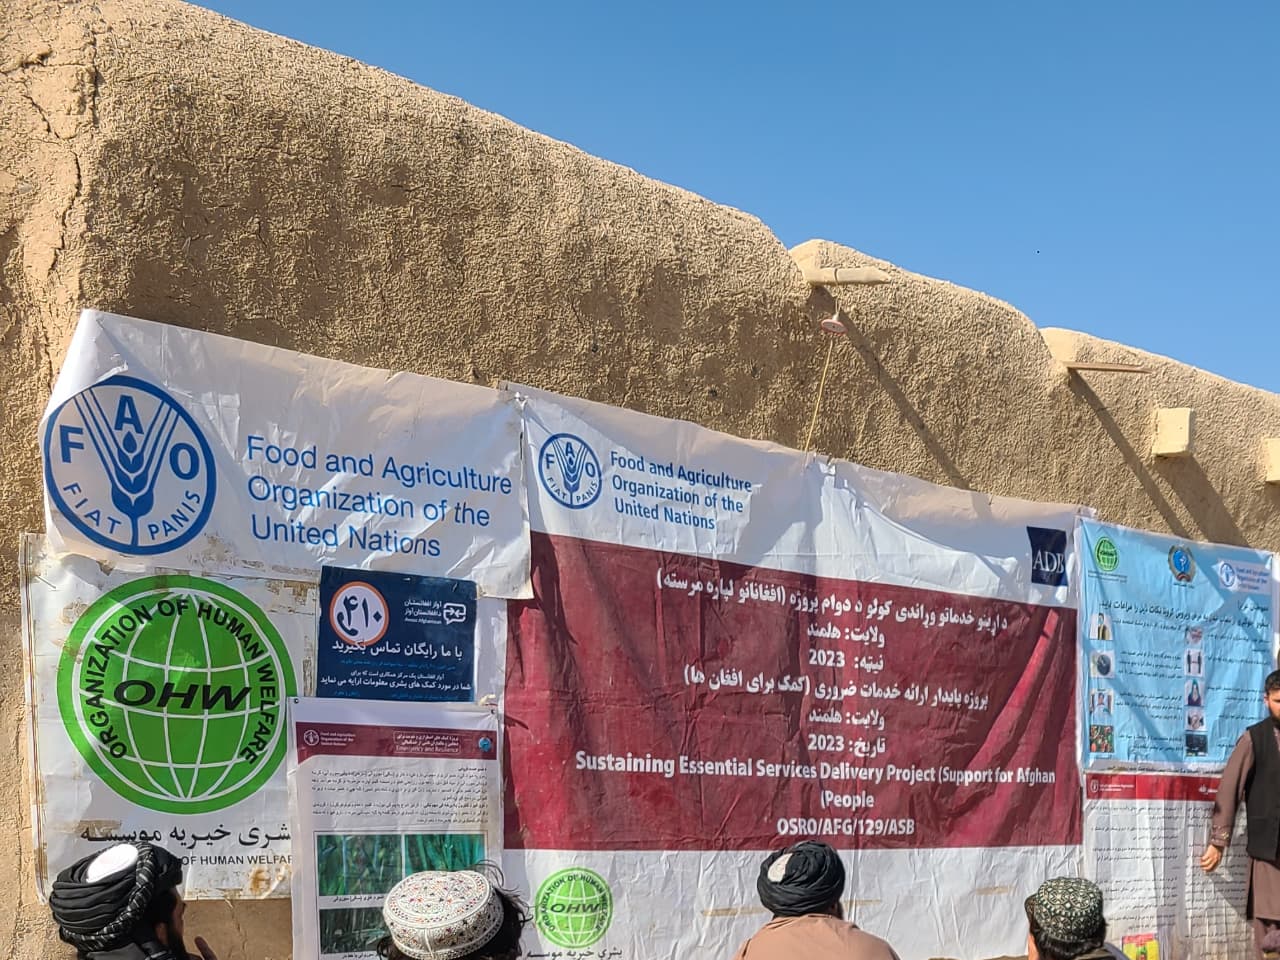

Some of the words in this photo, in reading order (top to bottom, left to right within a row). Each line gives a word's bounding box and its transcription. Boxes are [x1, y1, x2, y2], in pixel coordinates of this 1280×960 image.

[248, 436, 316, 470] Food
[325, 449, 374, 477] and
[382, 456, 513, 496] Agriculture
[611, 451, 645, 472] Food
[649, 461, 674, 478] and
[678, 468, 752, 492] Agriculture
[547, 477, 567, 499] FIAT
[576, 481, 597, 502] PANIS
[612, 474, 699, 504] Organization
[704, 493, 717, 508] of
[722, 496, 743, 513] the
[63, 481, 122, 536] FIAT
[149, 490, 201, 541] PANIS
[248, 476, 415, 519] Organization
[424, 497, 450, 522] of
[454, 502, 490, 527] the
[615, 498, 659, 520] United
[665, 510, 715, 530] Nations
[252, 514, 338, 549] United
[349, 525, 441, 557] Nations
[1033, 549, 1064, 573] ADB
[807, 622, 841, 639] هلمند
[370, 641, 400, 656] تماس
[404, 643, 438, 659] رایگان
[441, 645, 451, 657] ما
[455, 646, 462, 660] با
[809, 649, 845, 667] 2023
[81, 603, 153, 759] ORGANIZATION
[157, 599, 189, 617] OF
[198, 601, 269, 660] HUMAN
[240, 662, 276, 765] WELFARE
[746, 672, 775, 694] برای
[860, 681, 901, 699] خدمات
[113, 680, 253, 710] OHW
[809, 708, 842, 723] هلمند
[807, 734, 845, 751] 2023
[575, 750, 675, 778] Sustaining
[679, 756, 752, 777] Essential
[756, 759, 817, 779] Services
[820, 762, 883, 784] Delivery
[886, 765, 936, 786] Project
[938, 766, 993, 786] (Support
[994, 768, 1013, 783] for
[1016, 767, 1056, 786] Afghan
[821, 790, 874, 811] (People
[239, 823, 291, 848] شری
[776, 818, 915, 836] OSRO/AFG/129/ASB
[181, 856, 197, 865] OF
[201, 856, 244, 865] HUMAN
[247, 855, 292, 864] WELFA
[551, 903, 600, 913] OHW
